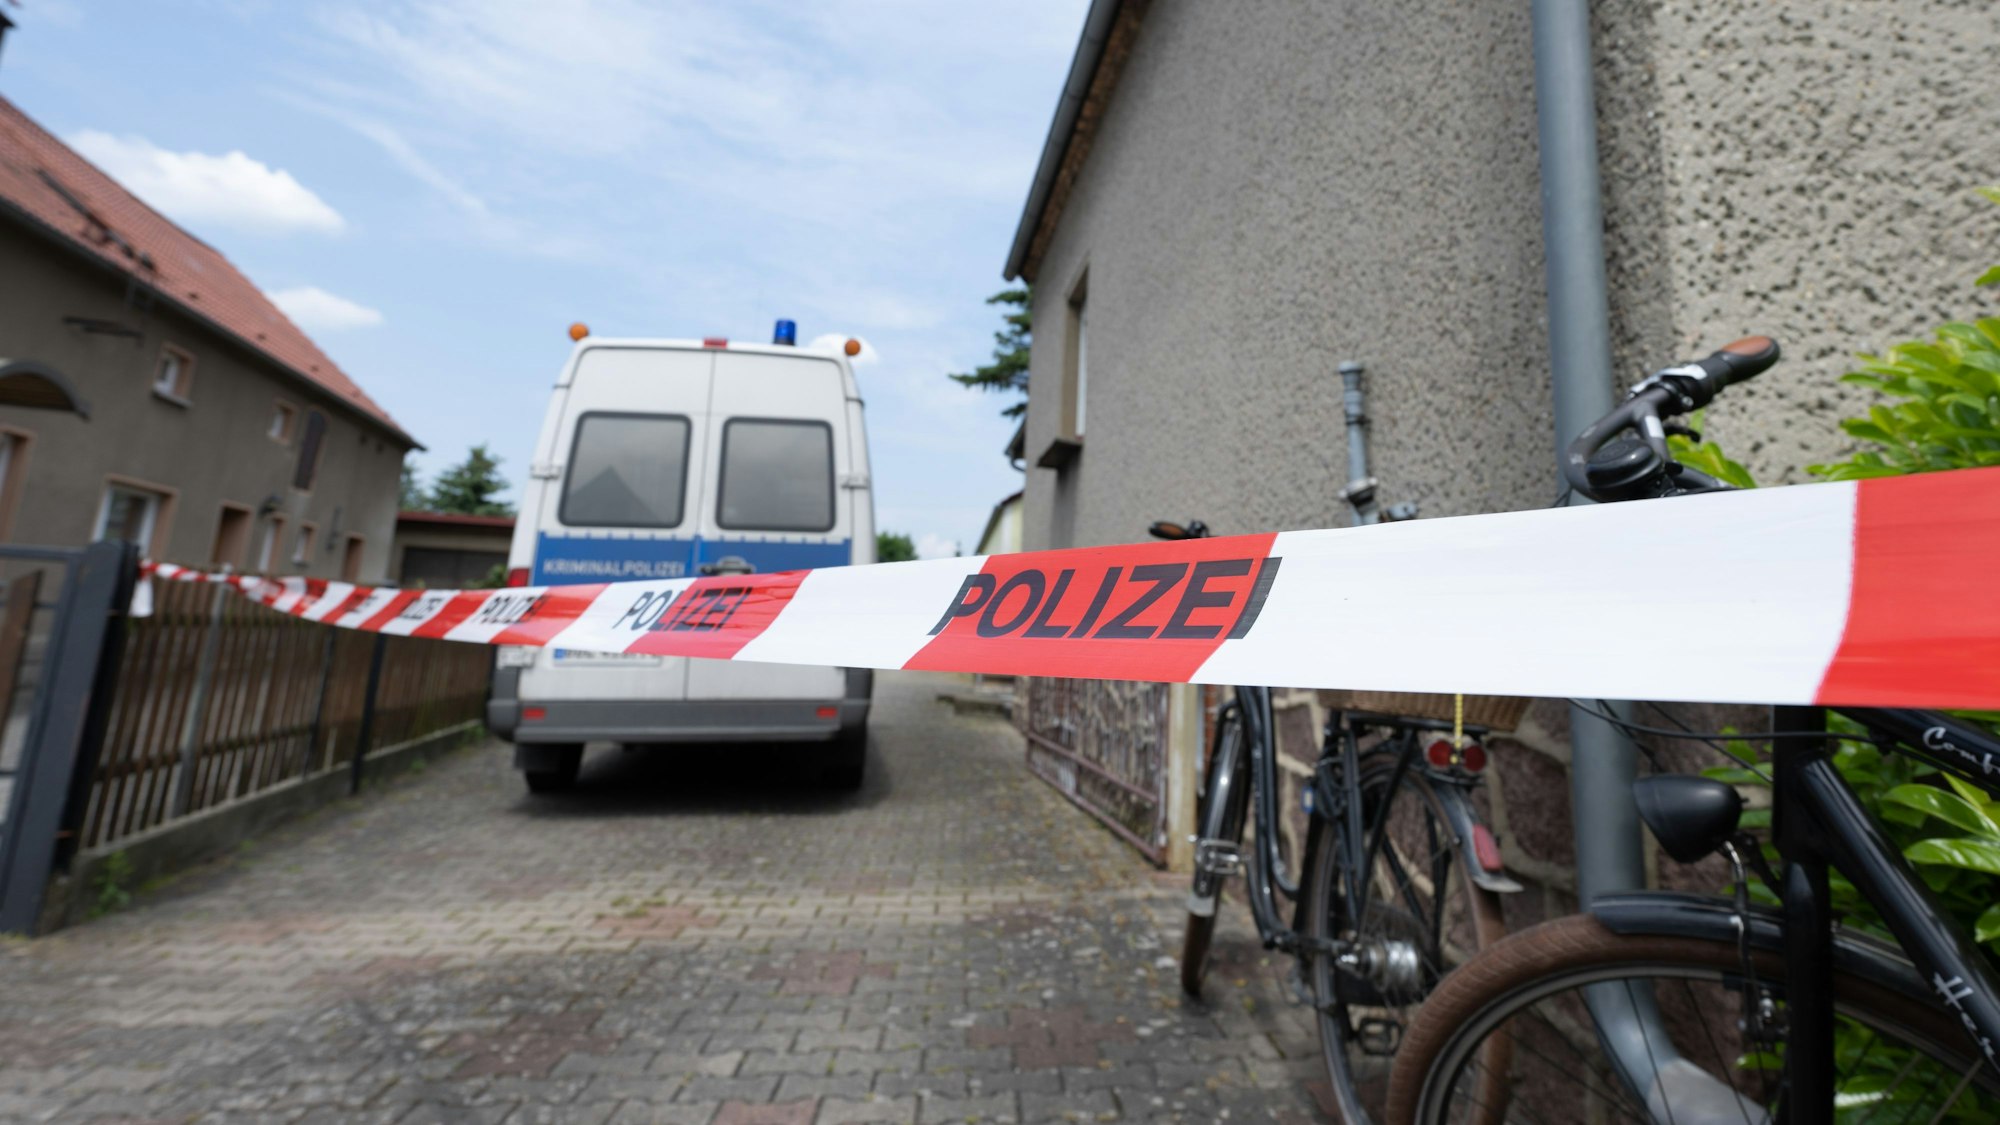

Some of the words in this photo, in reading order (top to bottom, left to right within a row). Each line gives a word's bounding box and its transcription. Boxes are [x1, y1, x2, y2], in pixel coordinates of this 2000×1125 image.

[543, 558, 686, 577] KRIMINALPOLIZEI
[927, 556, 1283, 639] POLIZEI
[611, 586, 753, 633] POLIZEI
[1933, 971, 2000, 1072] Her
